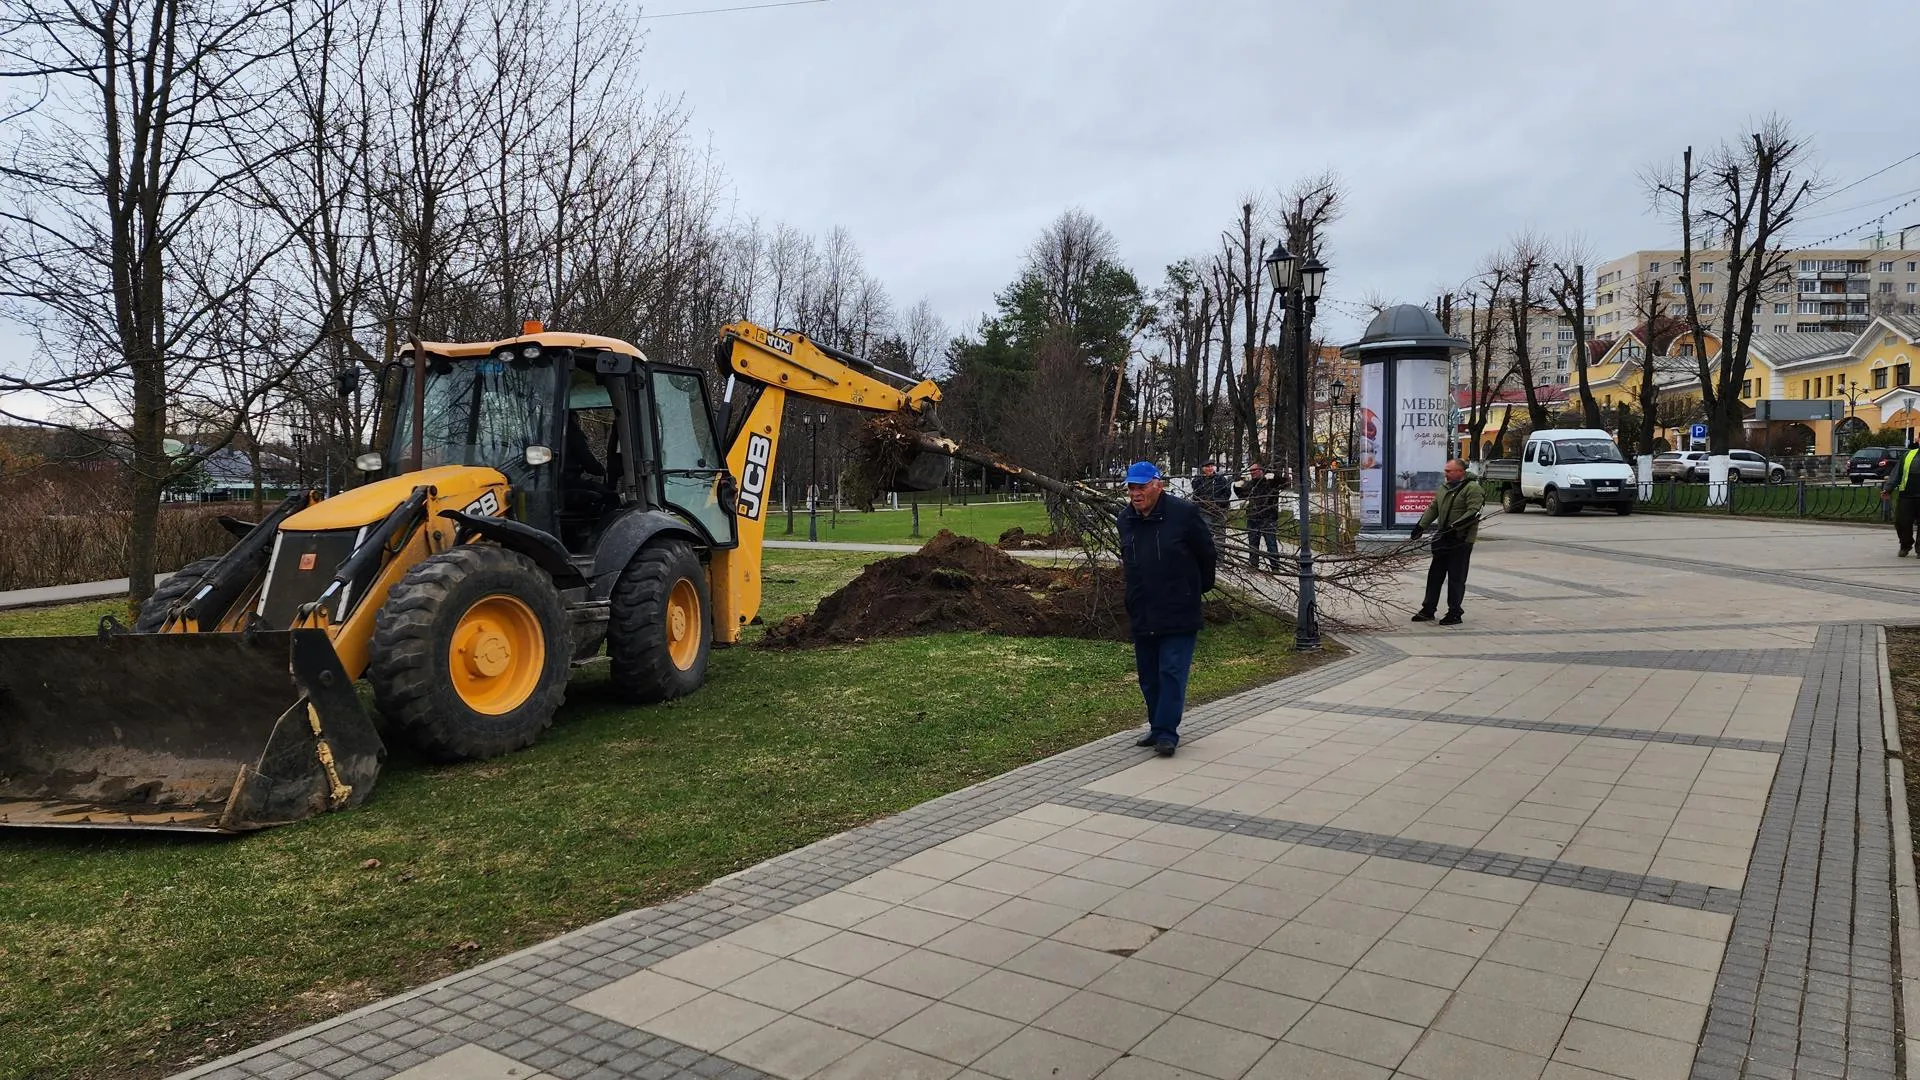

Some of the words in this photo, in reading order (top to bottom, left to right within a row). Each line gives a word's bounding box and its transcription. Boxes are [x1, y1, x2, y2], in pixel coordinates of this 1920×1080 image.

[1695, 426, 1704, 437] P
[740, 435, 770, 518] JCB
[460, 491, 498, 516] CB
